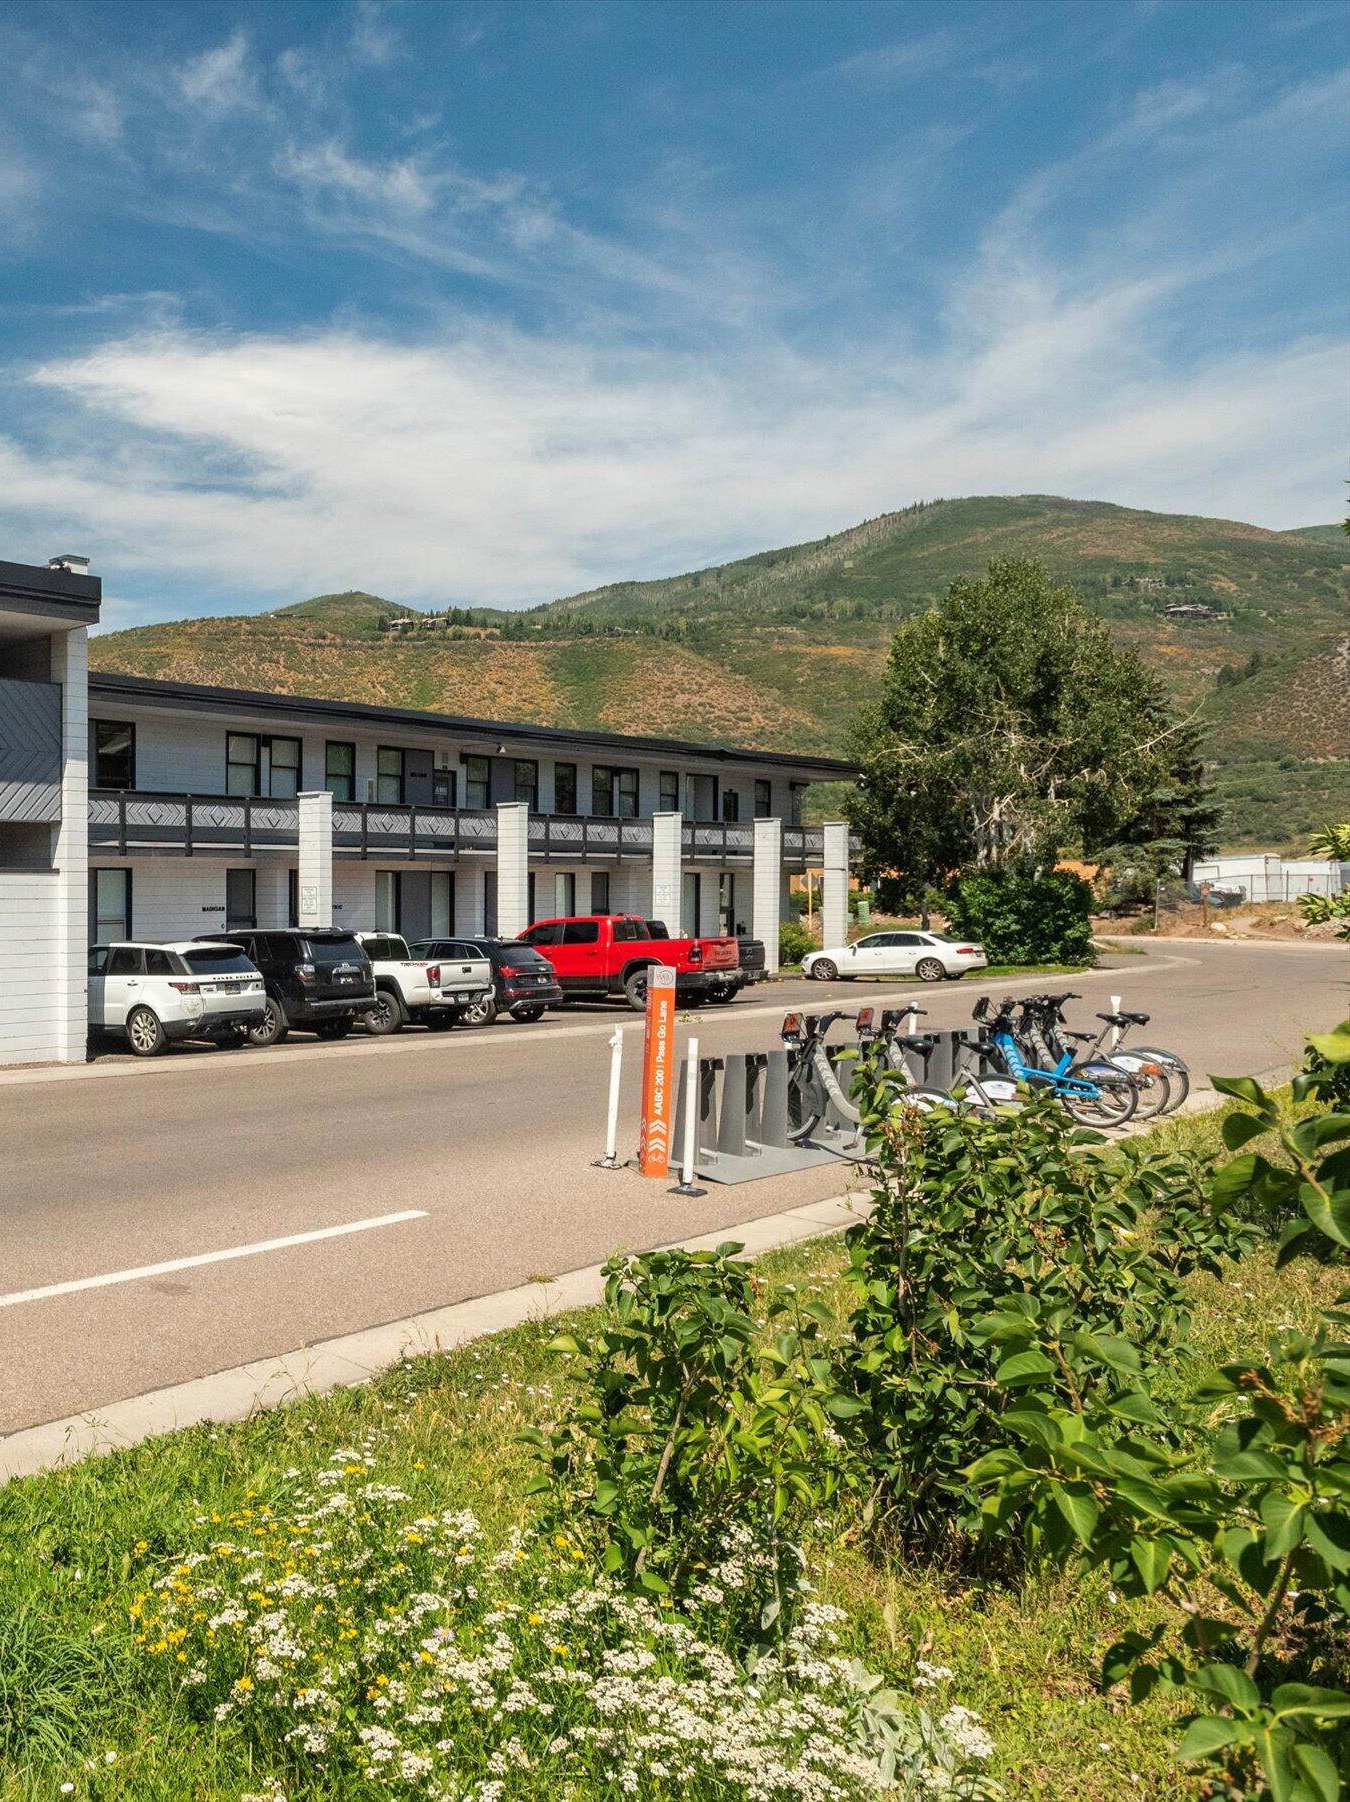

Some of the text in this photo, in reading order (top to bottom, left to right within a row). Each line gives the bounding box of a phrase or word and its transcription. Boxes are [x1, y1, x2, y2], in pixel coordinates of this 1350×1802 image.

[659, 1000, 667, 1022] Lane
[657, 1024, 666, 1039] Go
[656, 1040, 666, 1063] Pass
[653, 1087, 664, 1116] AABC
